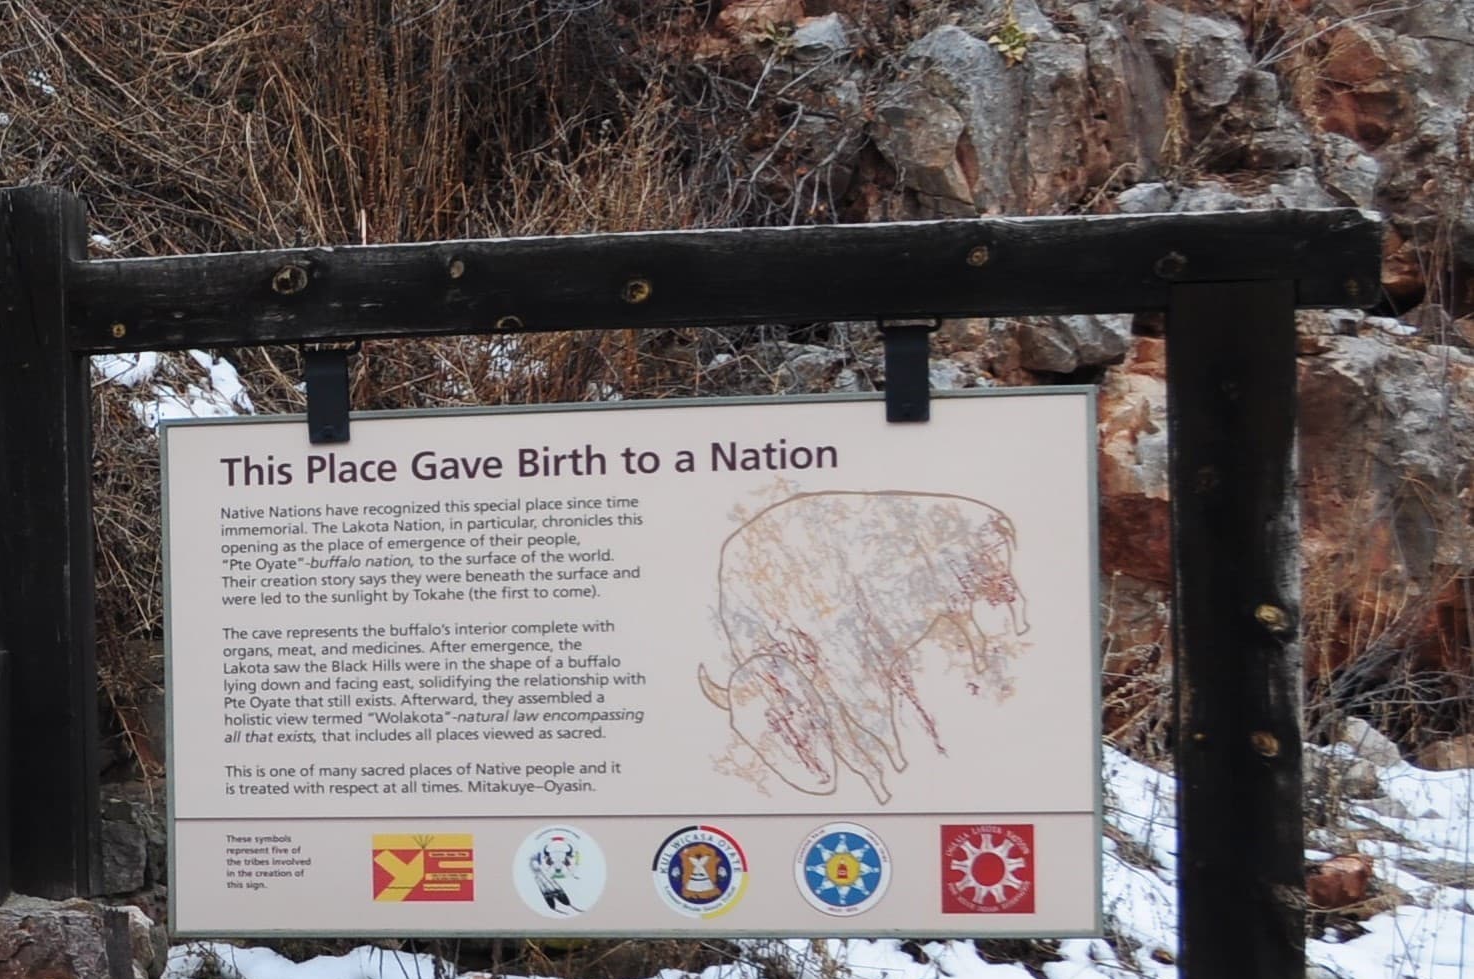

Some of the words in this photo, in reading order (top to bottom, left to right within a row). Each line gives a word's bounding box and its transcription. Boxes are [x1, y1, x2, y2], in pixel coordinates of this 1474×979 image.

[219, 454, 292, 486] This
[307, 452, 397, 484] Place
[411, 450, 502, 481] Gave
[518, 443, 606, 477] Birth
[620, 447, 660, 474] to
[674, 450, 694, 473] a
[711, 438, 837, 471] Nation
[220, 506, 264, 519] Native
[268, 505, 322, 518] Nations
[325, 503, 358, 516] have
[363, 500, 440, 517] recognized
[444, 499, 470, 513] this
[473, 497, 520, 515] special
[525, 497, 563, 513] place
[566, 496, 602, 509] since
[606, 495, 638, 508] time
[221, 521, 307, 536] immemorial.
[311, 521, 338, 534] The
[342, 519, 389, 533] Lakota
[393, 518, 444, 532] Nation,
[449, 517, 462, 530] in
[467, 515, 537, 533] particular,
[541, 513, 613, 528] chronicles
[617, 512, 643, 525] this
[220, 540, 278, 557] opening
[282, 542, 296, 552] as
[300, 538, 324, 552] the
[327, 537, 364, 554] place
[368, 536, 383, 550] of
[387, 537, 466, 552] emergence
[469, 533, 485, 547] of
[488, 533, 523, 547] their
[527, 531, 580, 549] people,
[365, 554, 414, 568] nation,
[419, 555, 434, 566] to
[438, 552, 462, 565] the
[465, 551, 517, 565] surface
[520, 550, 536, 563] of
[540, 550, 564, 563] the
[567, 548, 614, 562] world.
[221, 575, 257, 588] Their
[260, 573, 317, 587] creation
[320, 575, 355, 588] story
[358, 574, 387, 588] says
[390, 571, 421, 587] they
[425, 572, 461, 583] were
[465, 568, 525, 582] beneath
[528, 568, 553, 581] the
[556, 566, 608, 580] surface
[612, 565, 640, 579] and
[221, 626, 248, 640] The
[251, 629, 282, 639] cave
[286, 626, 358, 641] represents
[362, 623, 385, 637] the
[454, 622, 507, 635] interior
[511, 620, 578, 636] complete
[581, 619, 614, 632] with
[222, 646, 273, 660] organs,
[277, 644, 316, 657] meat,
[321, 642, 347, 655] and
[351, 641, 425, 654] medicines.
[429, 639, 466, 653] After
[470, 641, 553, 655] emergence,
[558, 637, 582, 651] the
[223, 661, 269, 674] Lakota
[273, 663, 300, 674] saw
[304, 660, 327, 673] the
[331, 659, 368, 672] Black
[372, 658, 401, 671] Hills
[404, 661, 440, 671] were
[444, 657, 458, 670] in
[461, 657, 486, 670] the
[489, 656, 531, 672] shape
[535, 655, 551, 669] of
[555, 658, 563, 668] a
[567, 654, 621, 668] buffalo
[223, 678, 256, 695] lying
[260, 677, 300, 691] down
[304, 676, 331, 690] and
[335, 676, 378, 692] facing
[382, 677, 414, 690] east,
[418, 674, 491, 691] solidifying
[495, 674, 520, 687] the
[523, 672, 609, 688] relationship
[612, 671, 646, 685] with
[224, 696, 246, 709] Pte
[249, 695, 291, 711] Oyate
[294, 695, 324, 708] that
[327, 694, 350, 707] still
[355, 693, 396, 707] exists.
[400, 692, 477, 707] Afterward,
[482, 692, 514, 708] they
[517, 690, 592, 704] assembled
[596, 693, 605, 703] a
[224, 712, 272, 726] holistic
[275, 712, 308, 726] view
[311, 711, 362, 725] termed
[512, 709, 539, 722] law
[542, 708, 644, 724] encompassing
[223, 730, 241, 743] all
[245, 730, 273, 743] that
[276, 730, 316, 744] exists,
[321, 729, 350, 742] that
[355, 728, 412, 741] includes
[415, 728, 431, 741] all
[436, 728, 479, 743] places
[482, 727, 534, 740] viewed
[538, 729, 553, 739] as
[556, 726, 606, 739] sacred.
[224, 764, 252, 778] This
[256, 764, 266, 777] is
[269, 767, 296, 777] one
[299, 763, 314, 777] of
[318, 767, 357, 780] many
[360, 762, 405, 776] sacred
[409, 762, 452, 779] places
[456, 761, 471, 775] of
[475, 762, 521, 775] Native
[525, 761, 575, 777] people
[579, 760, 606, 774] and
[611, 760, 621, 774] it
[225, 782, 235, 795] is
[238, 781, 289, 795] treated
[293, 781, 324, 794] with
[329, 783, 379, 796] respect
[382, 782, 397, 793] at
[400, 780, 417, 793] all
[421, 780, 462, 793] times.
[225, 834, 252, 843] These
[254, 834, 292, 845] symbols
[226, 847, 269, 856] represent
[271, 845, 288, 854] five
[226, 857, 241, 866] the
[243, 857, 270, 866] tribes
[271, 857, 311, 866] involved
[237, 869, 252, 877] the
[254, 868, 292, 877] creation
[226, 880, 243, 889] this
[245, 880, 267, 891] sign.
